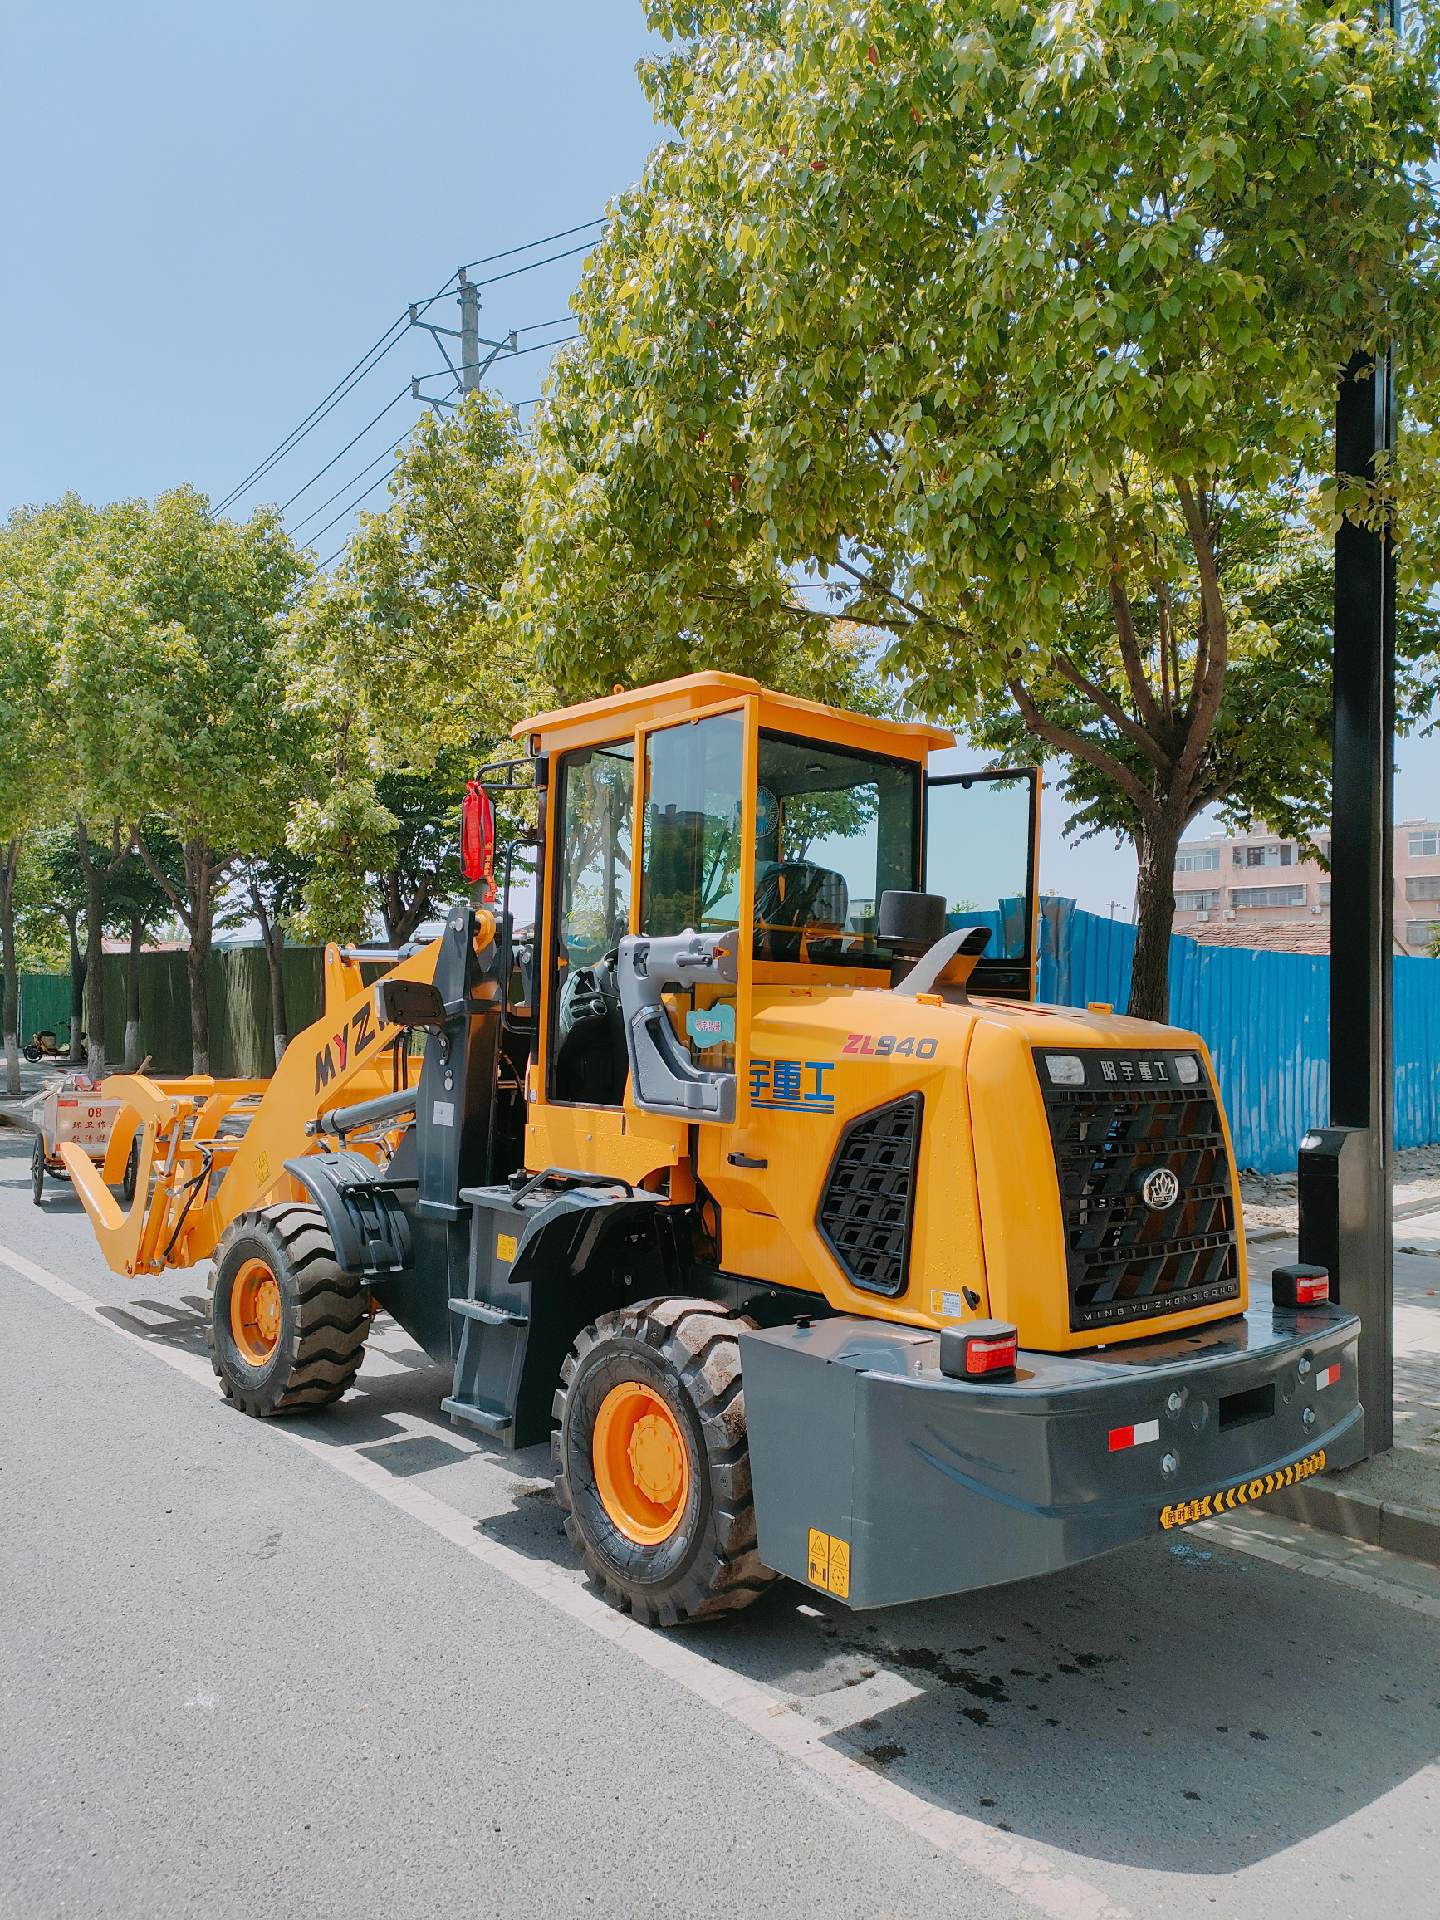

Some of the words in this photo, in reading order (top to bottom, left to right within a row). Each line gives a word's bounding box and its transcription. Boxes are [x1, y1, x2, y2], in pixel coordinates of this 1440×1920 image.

[314, 1000, 384, 1096] MYZ
[842, 1034, 939, 1060] ZL940
[1101, 1060, 1169, 1081] 明宇重工
[87, 1107, 102, 1118] 08
[71, 1121, 113, 1130] 环卫作
[1084, 1307, 1125, 1321] MING
[1131, 1304, 1148, 1313] YU
